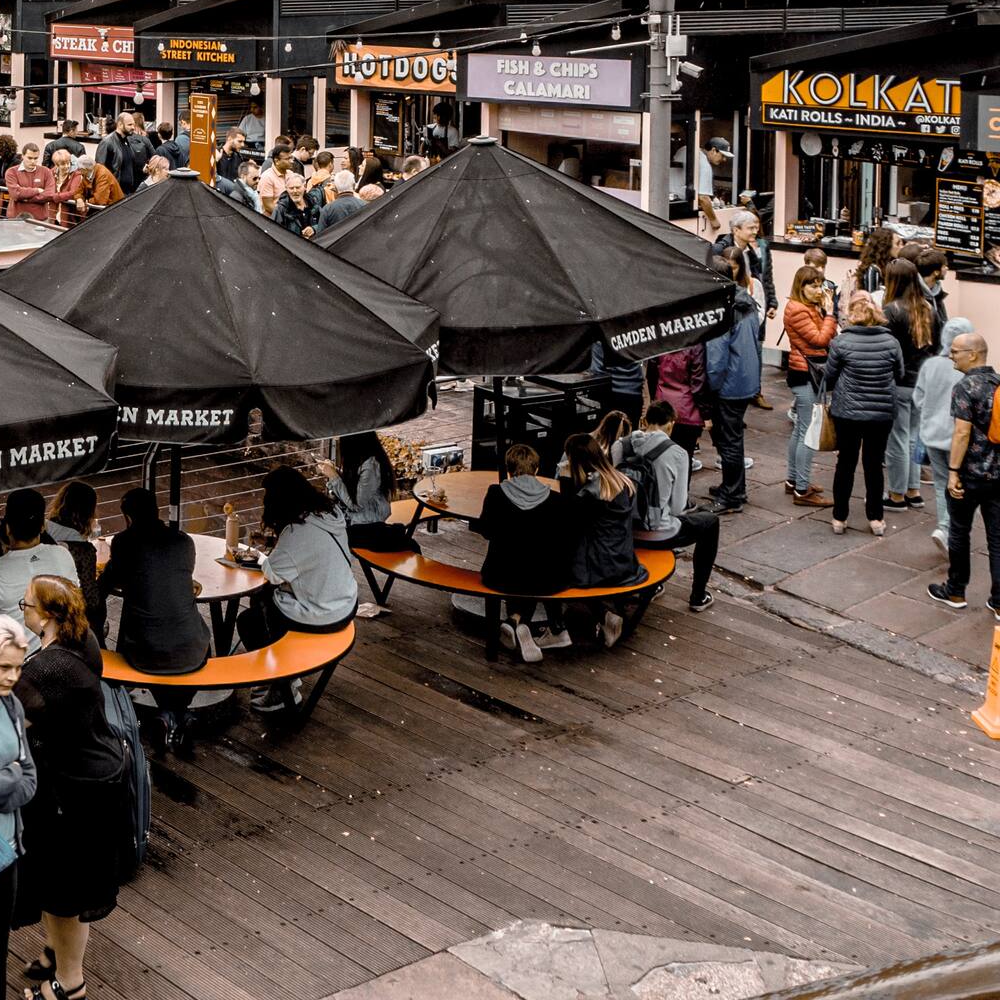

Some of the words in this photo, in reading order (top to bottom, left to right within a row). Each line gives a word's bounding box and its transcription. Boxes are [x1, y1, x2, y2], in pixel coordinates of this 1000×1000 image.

[55, 37, 97, 51] STEAK
[170, 40, 223, 50] INDONESIAN
[161, 50, 191, 60] STREET
[197, 52, 235, 63] KITCHEN
[497, 59, 529, 75] FISH
[533, 61, 546, 76] &
[550, 62, 599, 79] CHIPS
[504, 80, 591, 100] CALAMARI
[770, 108, 798, 121] KATI
[801, 110, 842, 124] ROLLS
[856, 114, 896, 128] INDIA
[611, 325, 656, 351] CAMDEN
[660, 307, 726, 337] MARKET
[145, 408, 234, 427] MARKET
[9, 435, 99, 467] MARKET
